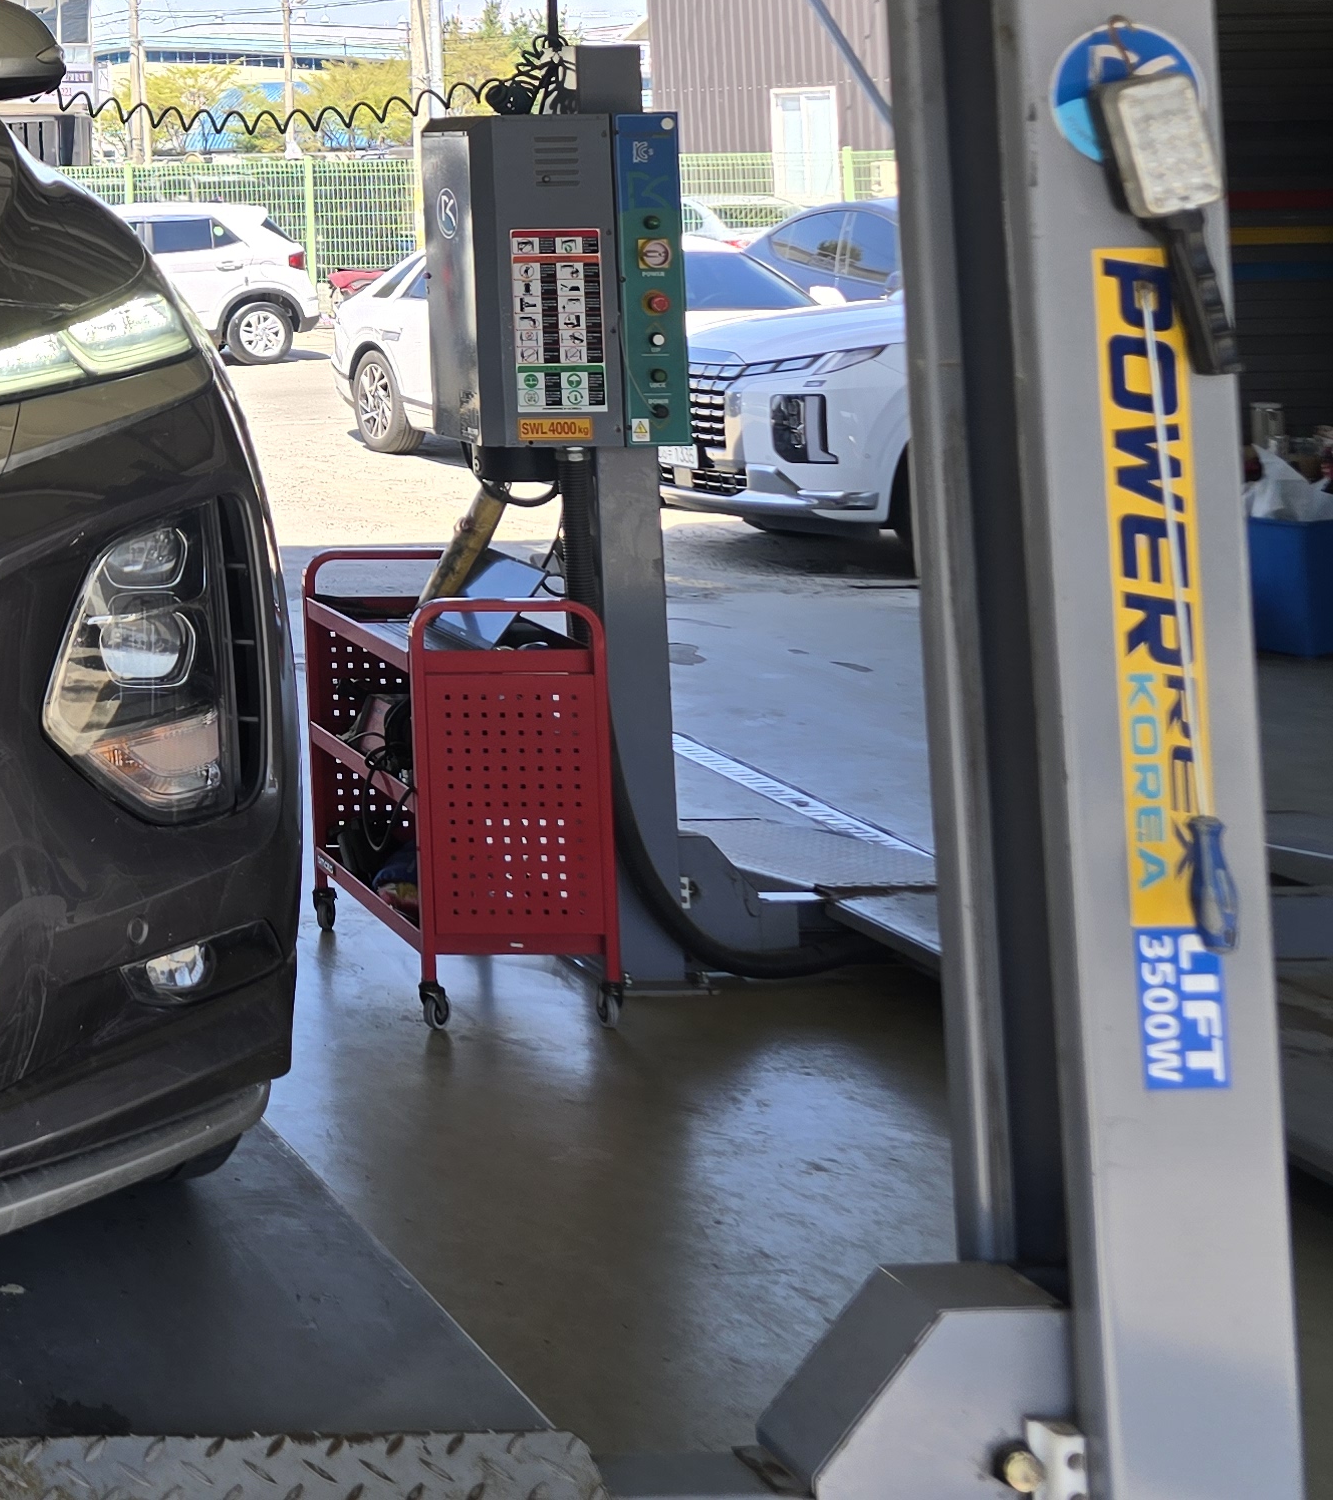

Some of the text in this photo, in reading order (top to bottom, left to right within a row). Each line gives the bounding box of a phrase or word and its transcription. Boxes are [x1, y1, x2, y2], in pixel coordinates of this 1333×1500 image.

[521, 422, 547, 435] SWL
[548, 421, 577, 435] 4000
[1126, 672, 1168, 890] KOREA
[1139, 934, 1185, 1082] 3500W
[1178, 933, 1226, 1082] LIFT
